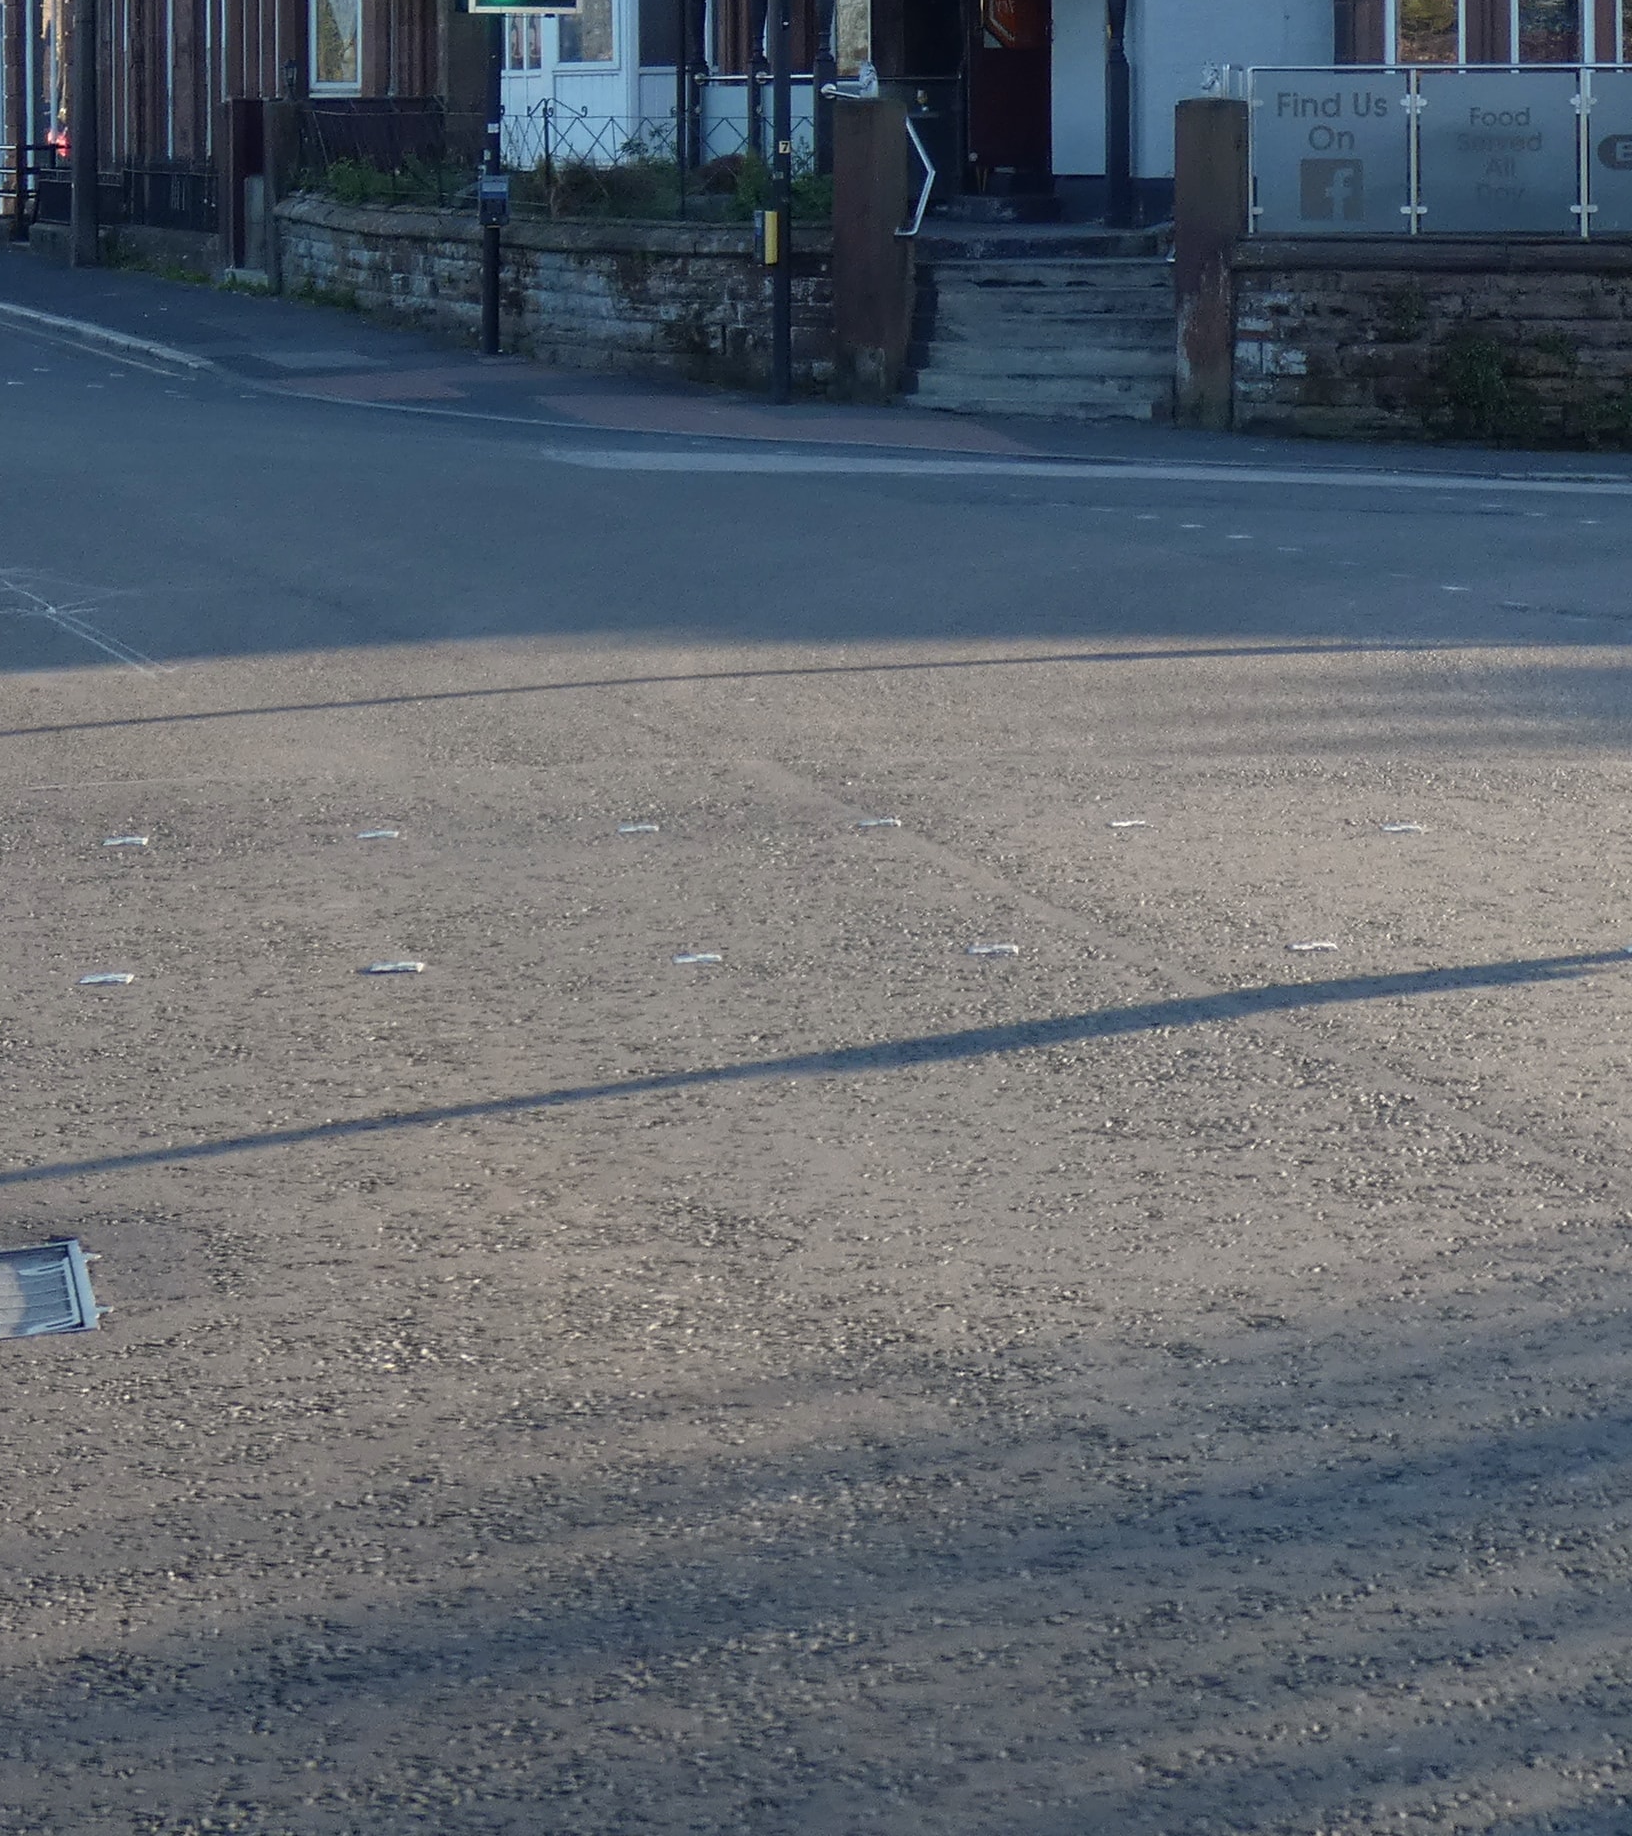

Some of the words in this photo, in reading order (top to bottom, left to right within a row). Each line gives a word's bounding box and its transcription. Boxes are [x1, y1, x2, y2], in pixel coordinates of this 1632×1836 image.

[1277, 92, 1341, 118] Find
[1353, 92, 1388, 118] Us
[1469, 106, 1531, 127] Food
[782, 142, 789, 151] 7
[1308, 125, 1355, 151] On
